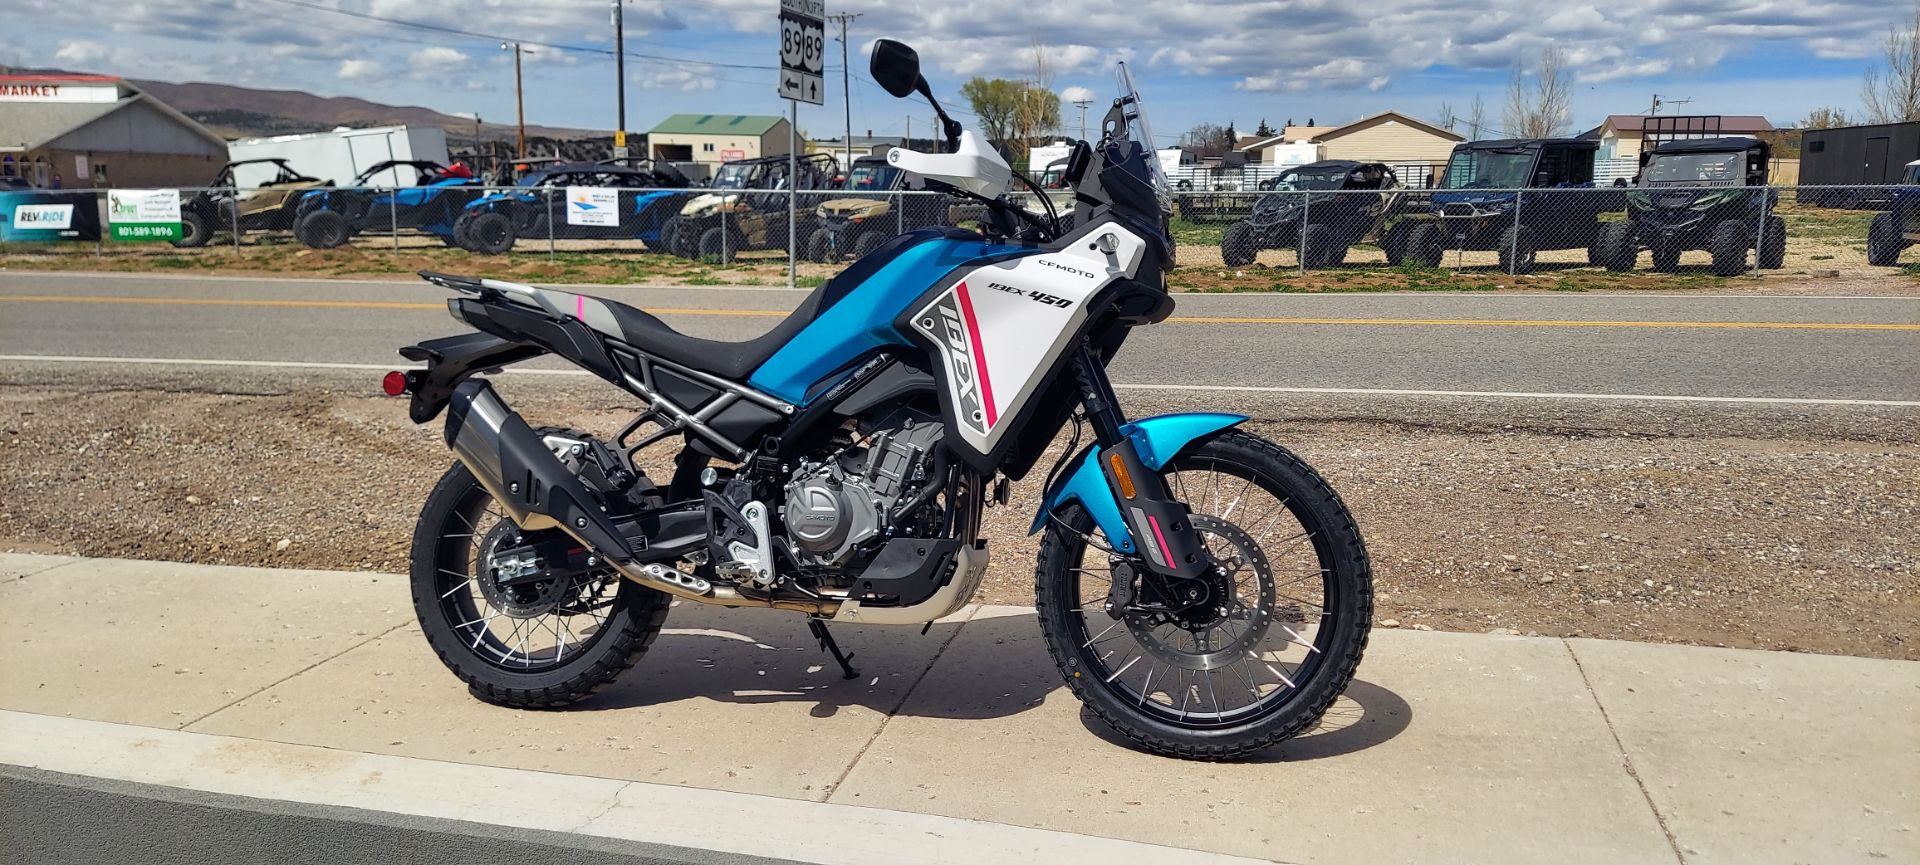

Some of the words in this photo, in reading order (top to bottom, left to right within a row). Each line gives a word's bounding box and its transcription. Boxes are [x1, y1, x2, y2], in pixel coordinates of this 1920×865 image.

[784, 27, 801, 55] 89
[805, 35, 822, 61] 89
[0, 84, 60, 97] MARKET
[118, 226, 173, 237] 801-589-1896
[1038, 259, 1095, 279] CFMOTO
[987, 282, 1027, 296] IBEX
[1028, 290, 1074, 309] 450
[938, 304, 980, 406] IBEX
